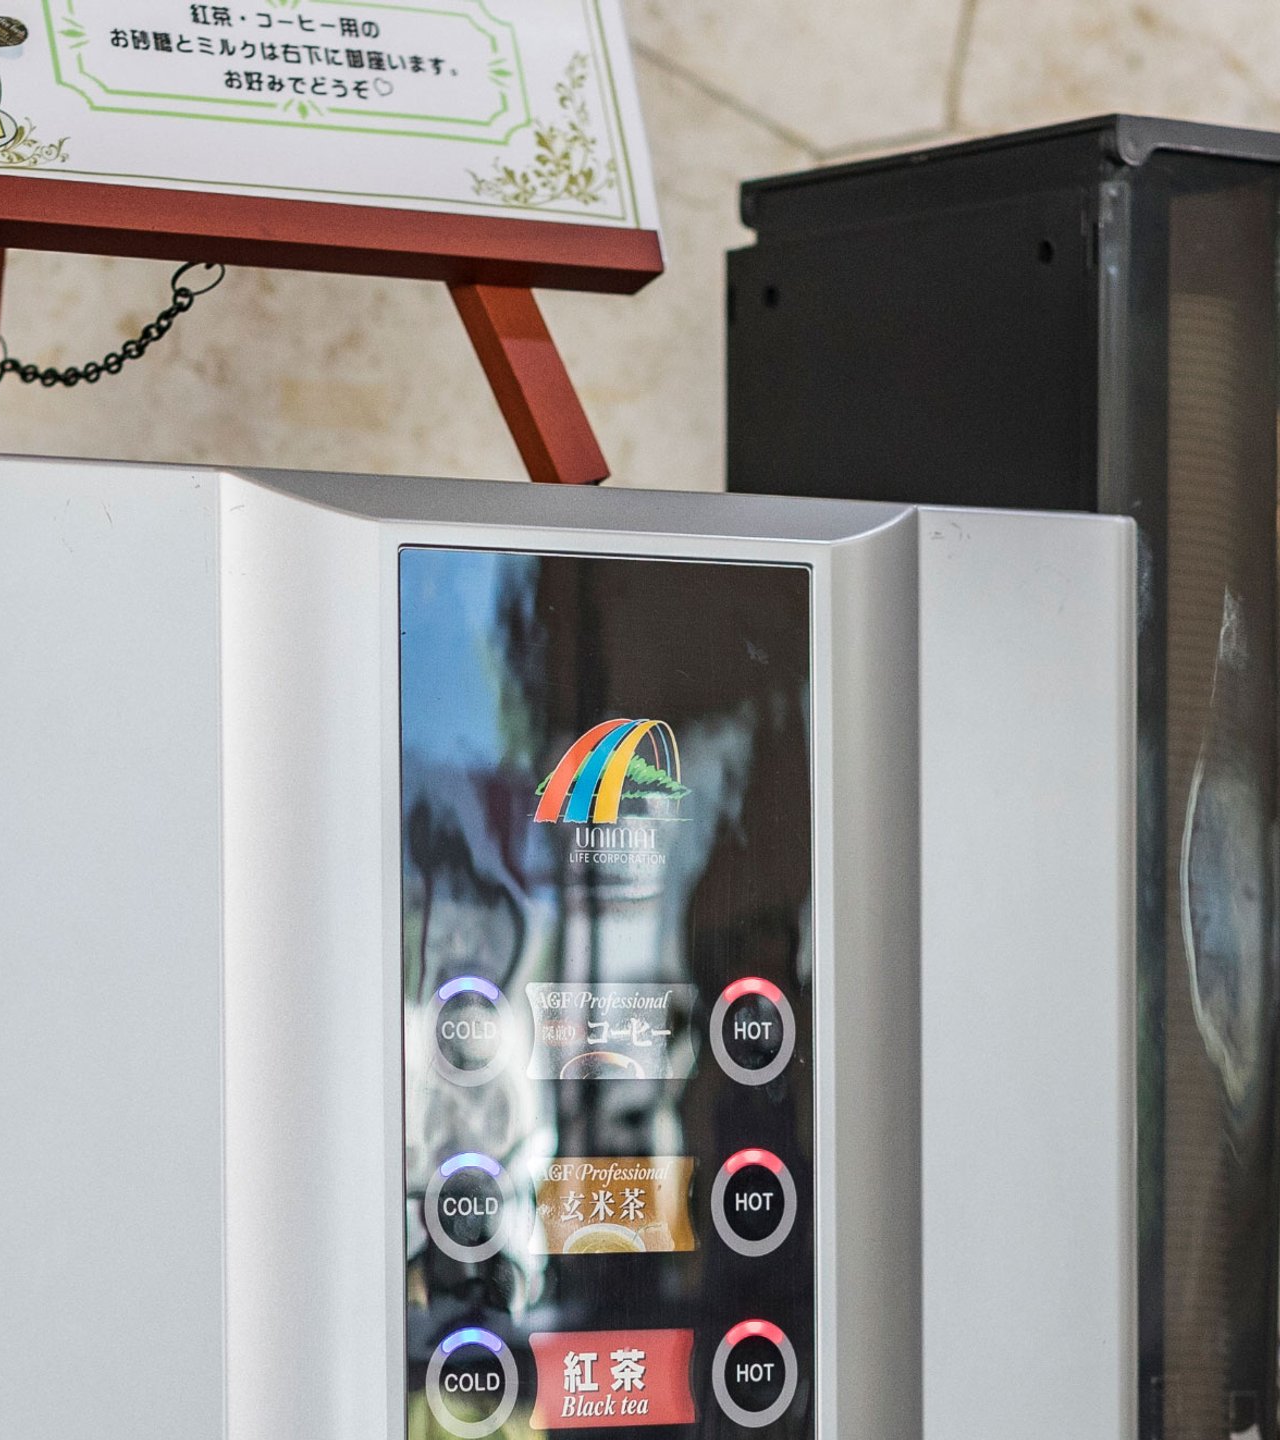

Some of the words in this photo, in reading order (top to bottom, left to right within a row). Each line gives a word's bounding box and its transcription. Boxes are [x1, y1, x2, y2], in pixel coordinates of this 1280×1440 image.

[575, 827, 658, 849] UNIMAT
[569, 853, 589, 863] LIFE
[593, 853, 666, 865] CORPORATION
[575, 990, 673, 1016] Professional
[441, 1020, 497, 1040] COLD
[733, 1021, 772, 1040] HOT
[576, 1163, 671, 1187] Professional
[442, 1197, 499, 1217] COLD
[560, 1188, 646, 1221] 玄米茶
[735, 1192, 774, 1211] HOT
[563, 1349, 647, 1393] 紅茶
[736, 1363, 774, 1383] HOT
[444, 1372, 500, 1392] COLD
[561, 1395, 615, 1418] Black
[621, 1396, 649, 1415] tea
